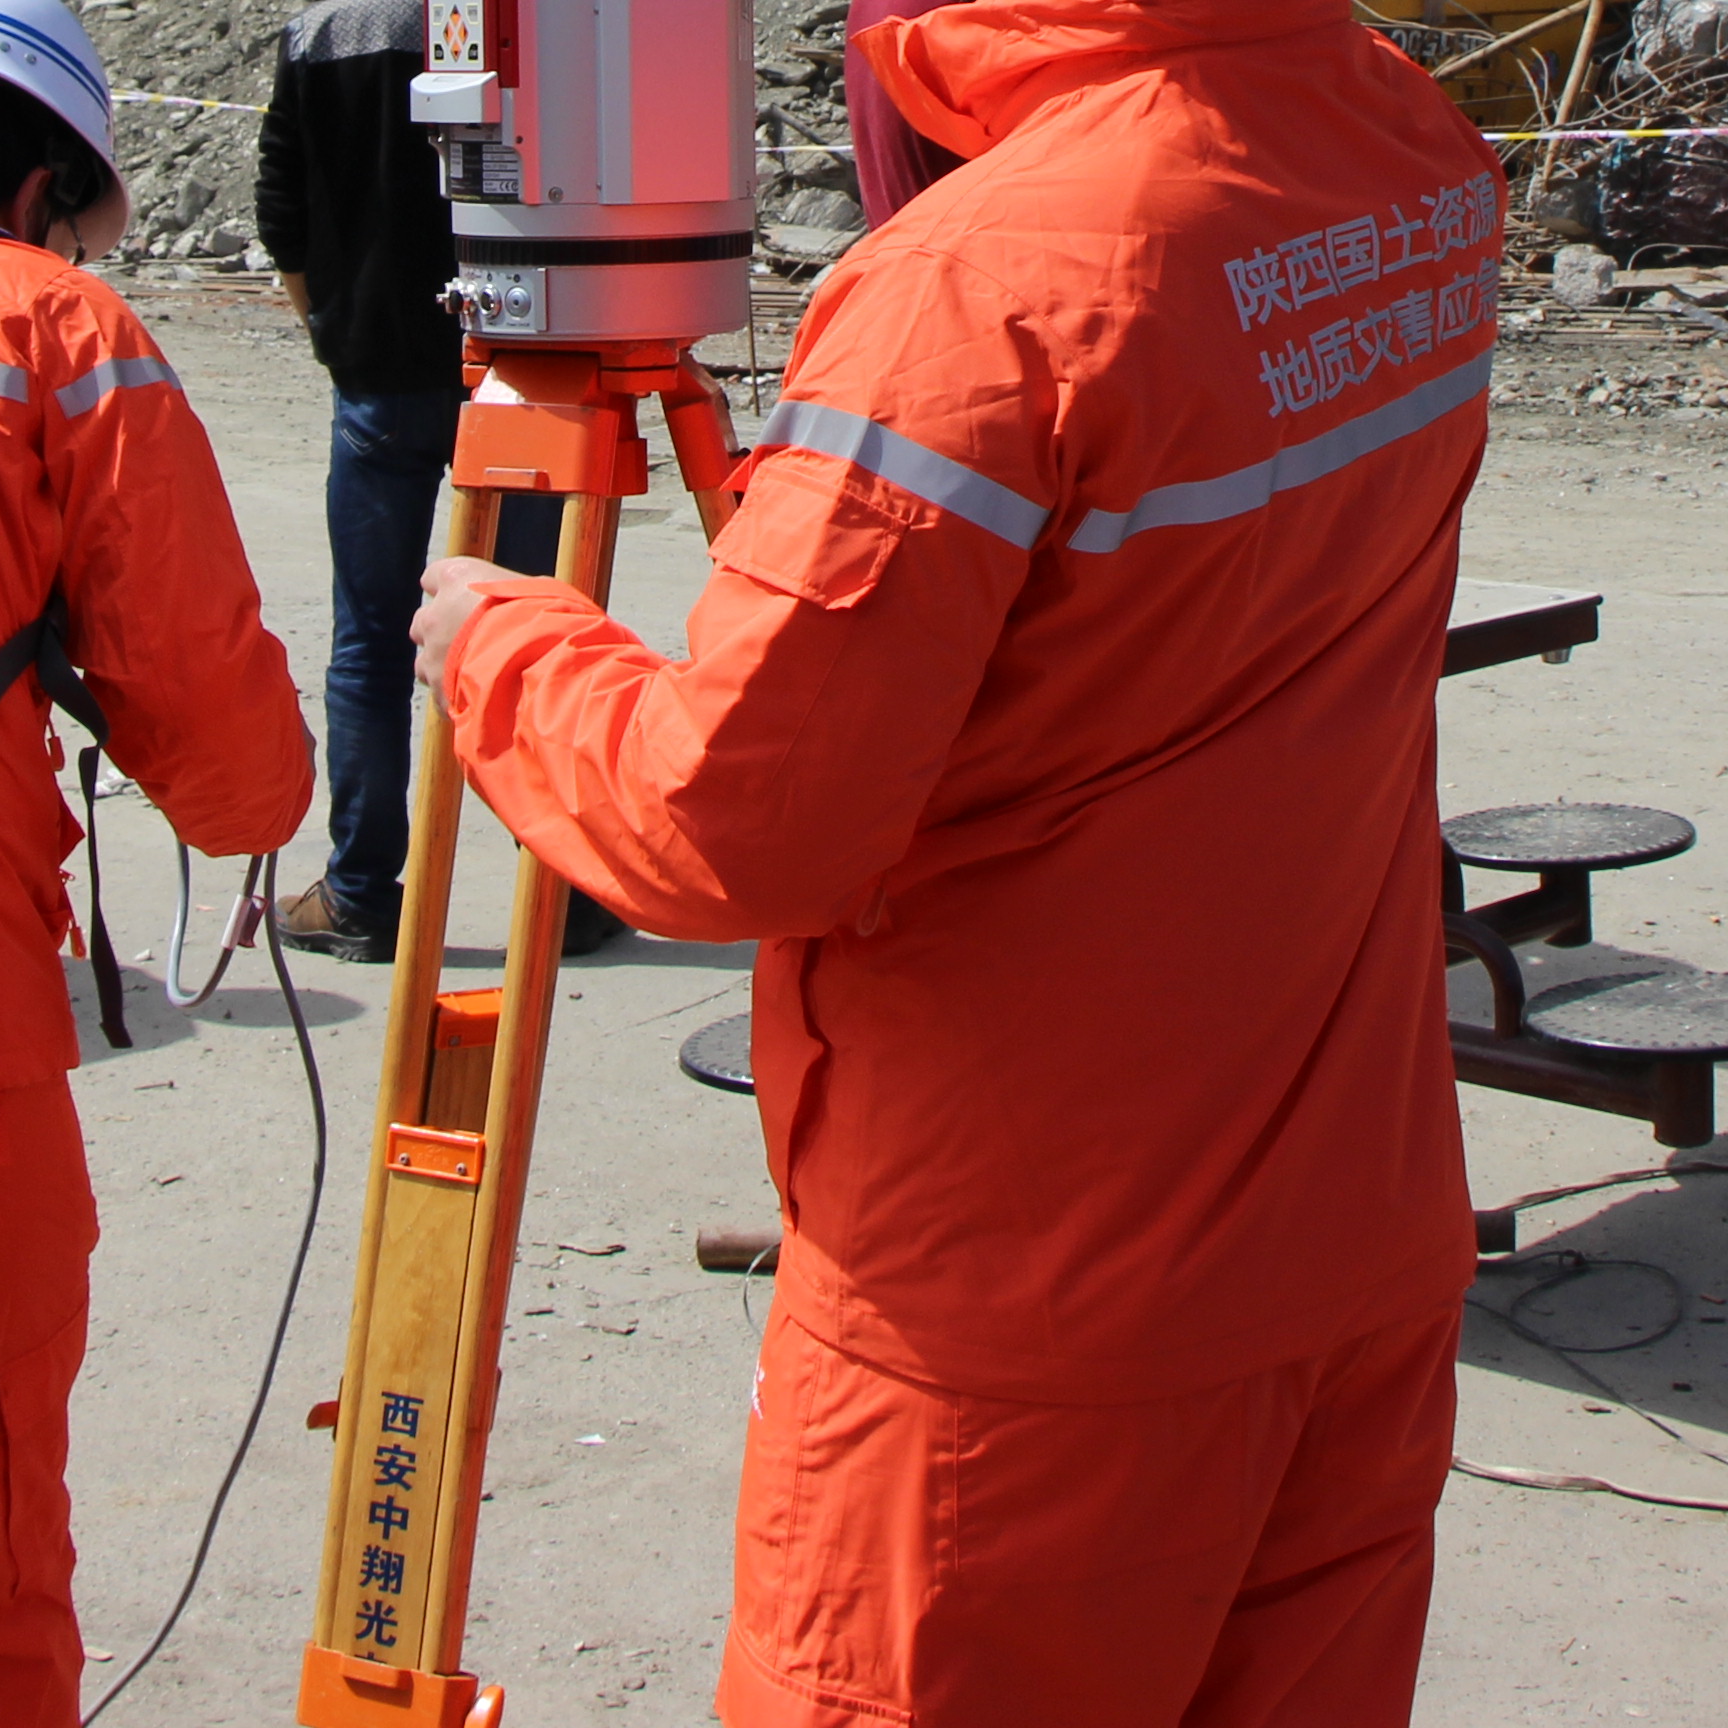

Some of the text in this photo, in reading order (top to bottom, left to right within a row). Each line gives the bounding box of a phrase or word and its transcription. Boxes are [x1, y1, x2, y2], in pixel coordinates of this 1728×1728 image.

[1223, 171, 1498, 332] 陕西国土资源
[1259, 256, 1501, 418] 地质灾害应急
[355, 1391, 424, 1665] 西安中翔光
